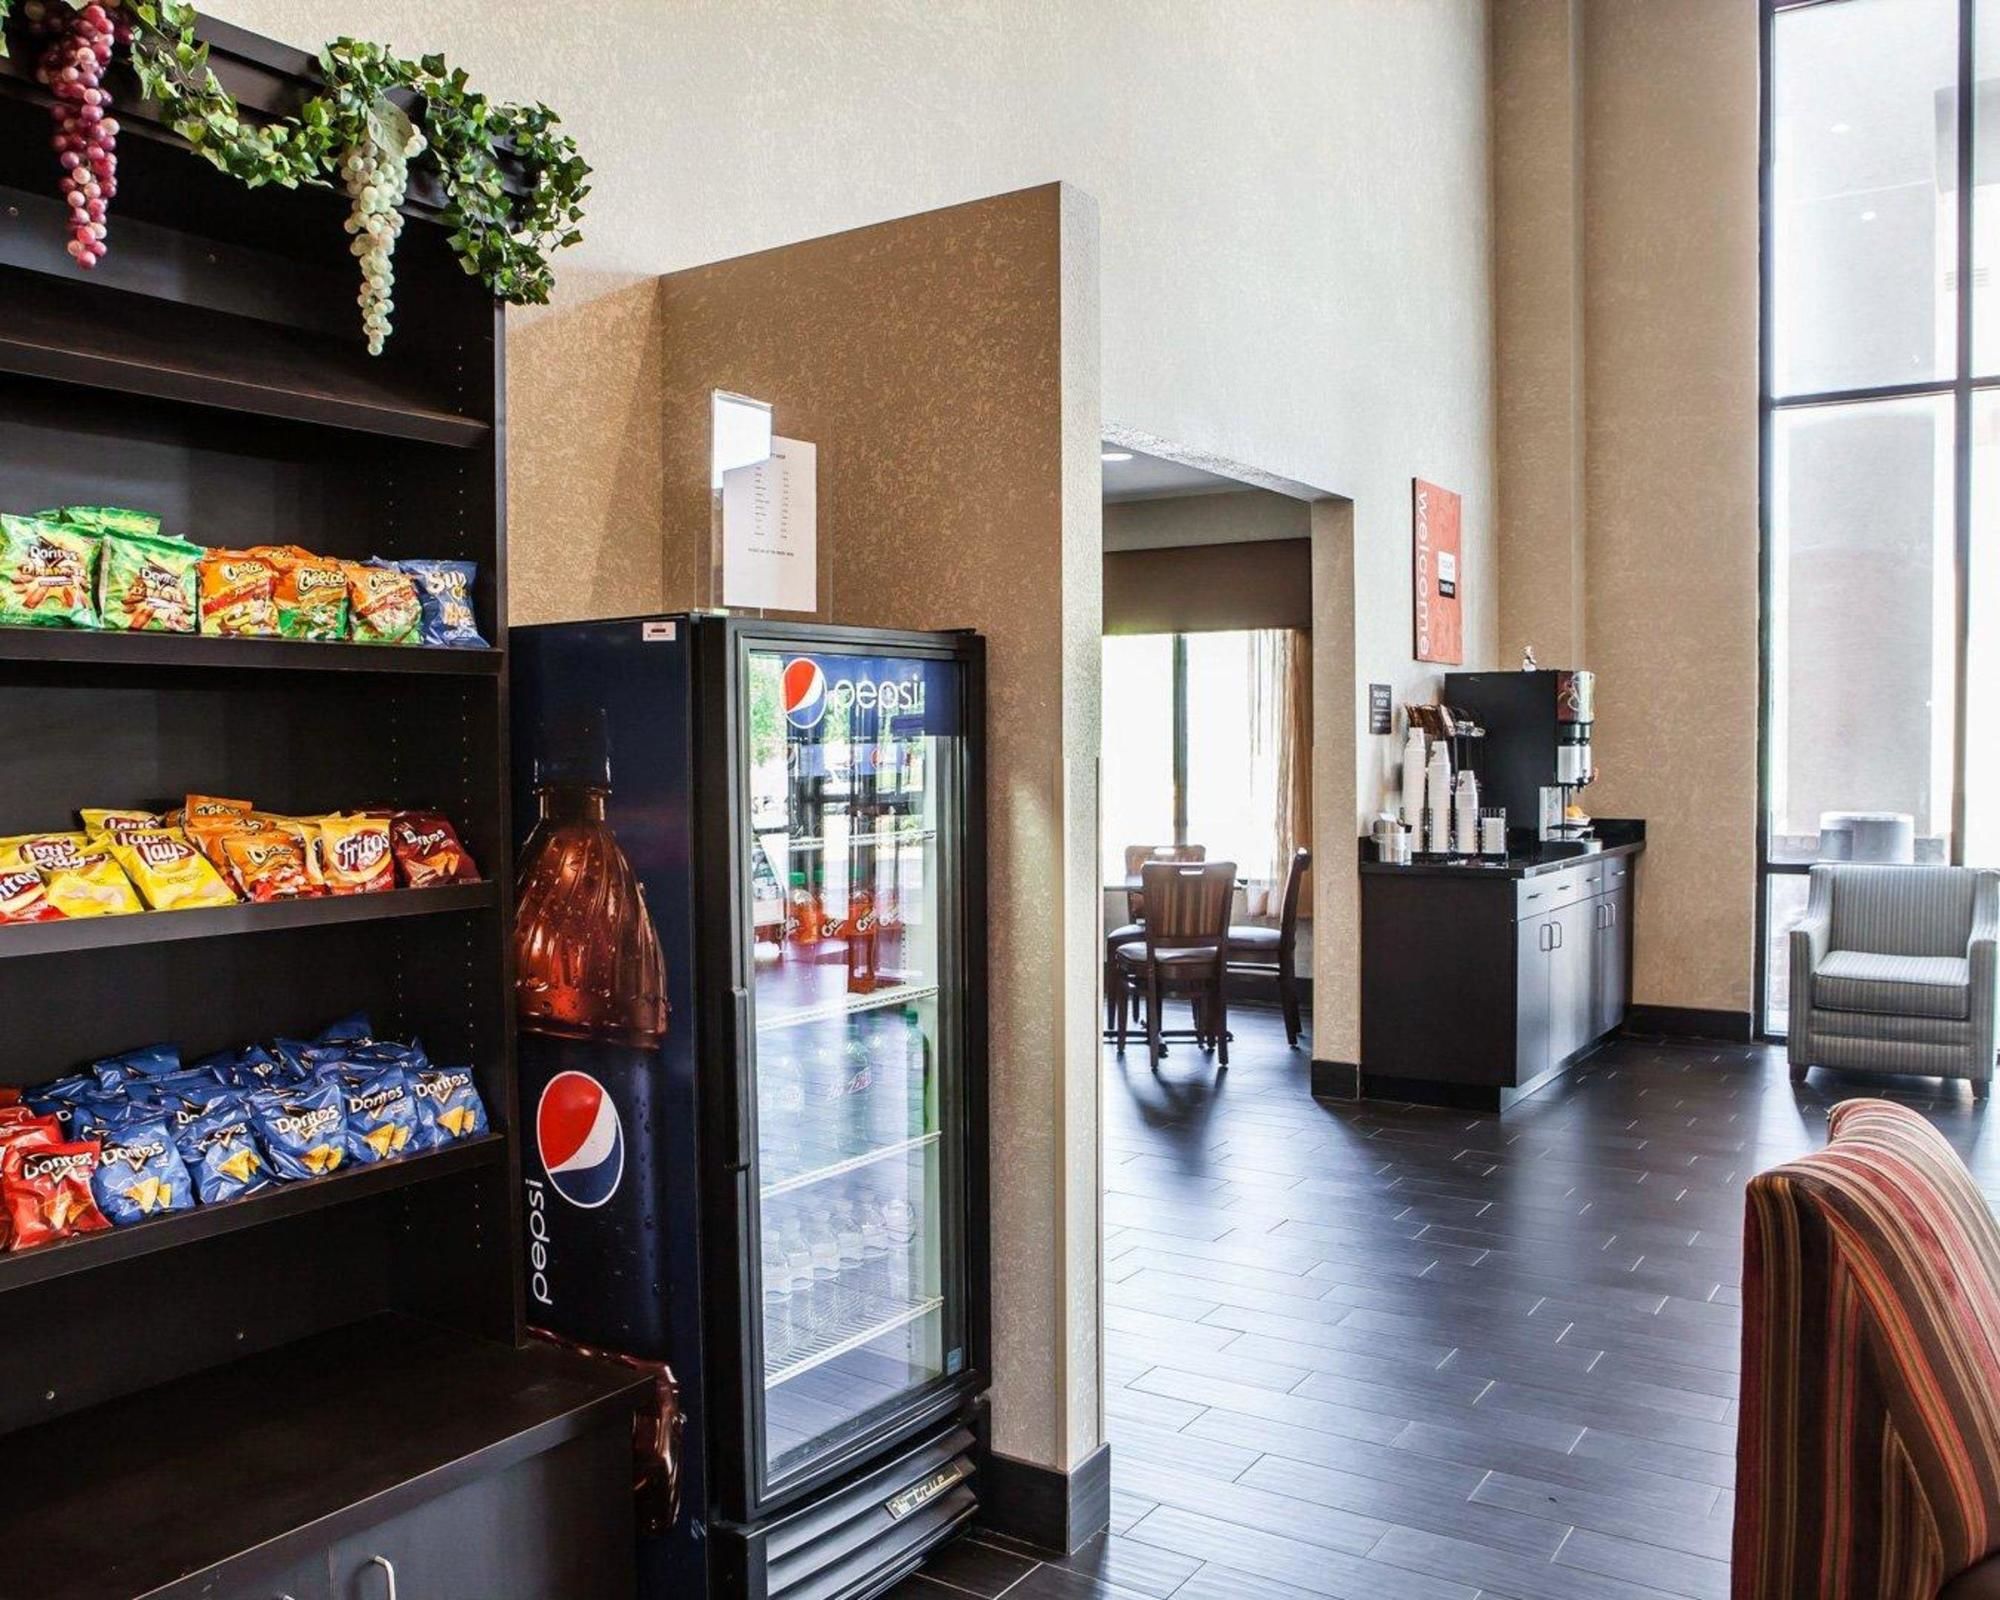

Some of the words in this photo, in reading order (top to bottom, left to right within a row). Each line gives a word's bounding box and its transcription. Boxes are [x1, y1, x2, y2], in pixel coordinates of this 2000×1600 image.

[1418, 491, 1430, 656] welcome
[833, 673, 920, 716] pepsi
[335, 833, 389, 870] Fritos
[350, 1085, 404, 1113] Doritos
[415, 1073, 469, 1097] Doritos
[275, 1105, 341, 1135] Doritos
[101, 1141, 165, 1165] Doritos
[526, 1178, 553, 1305] pepsi
